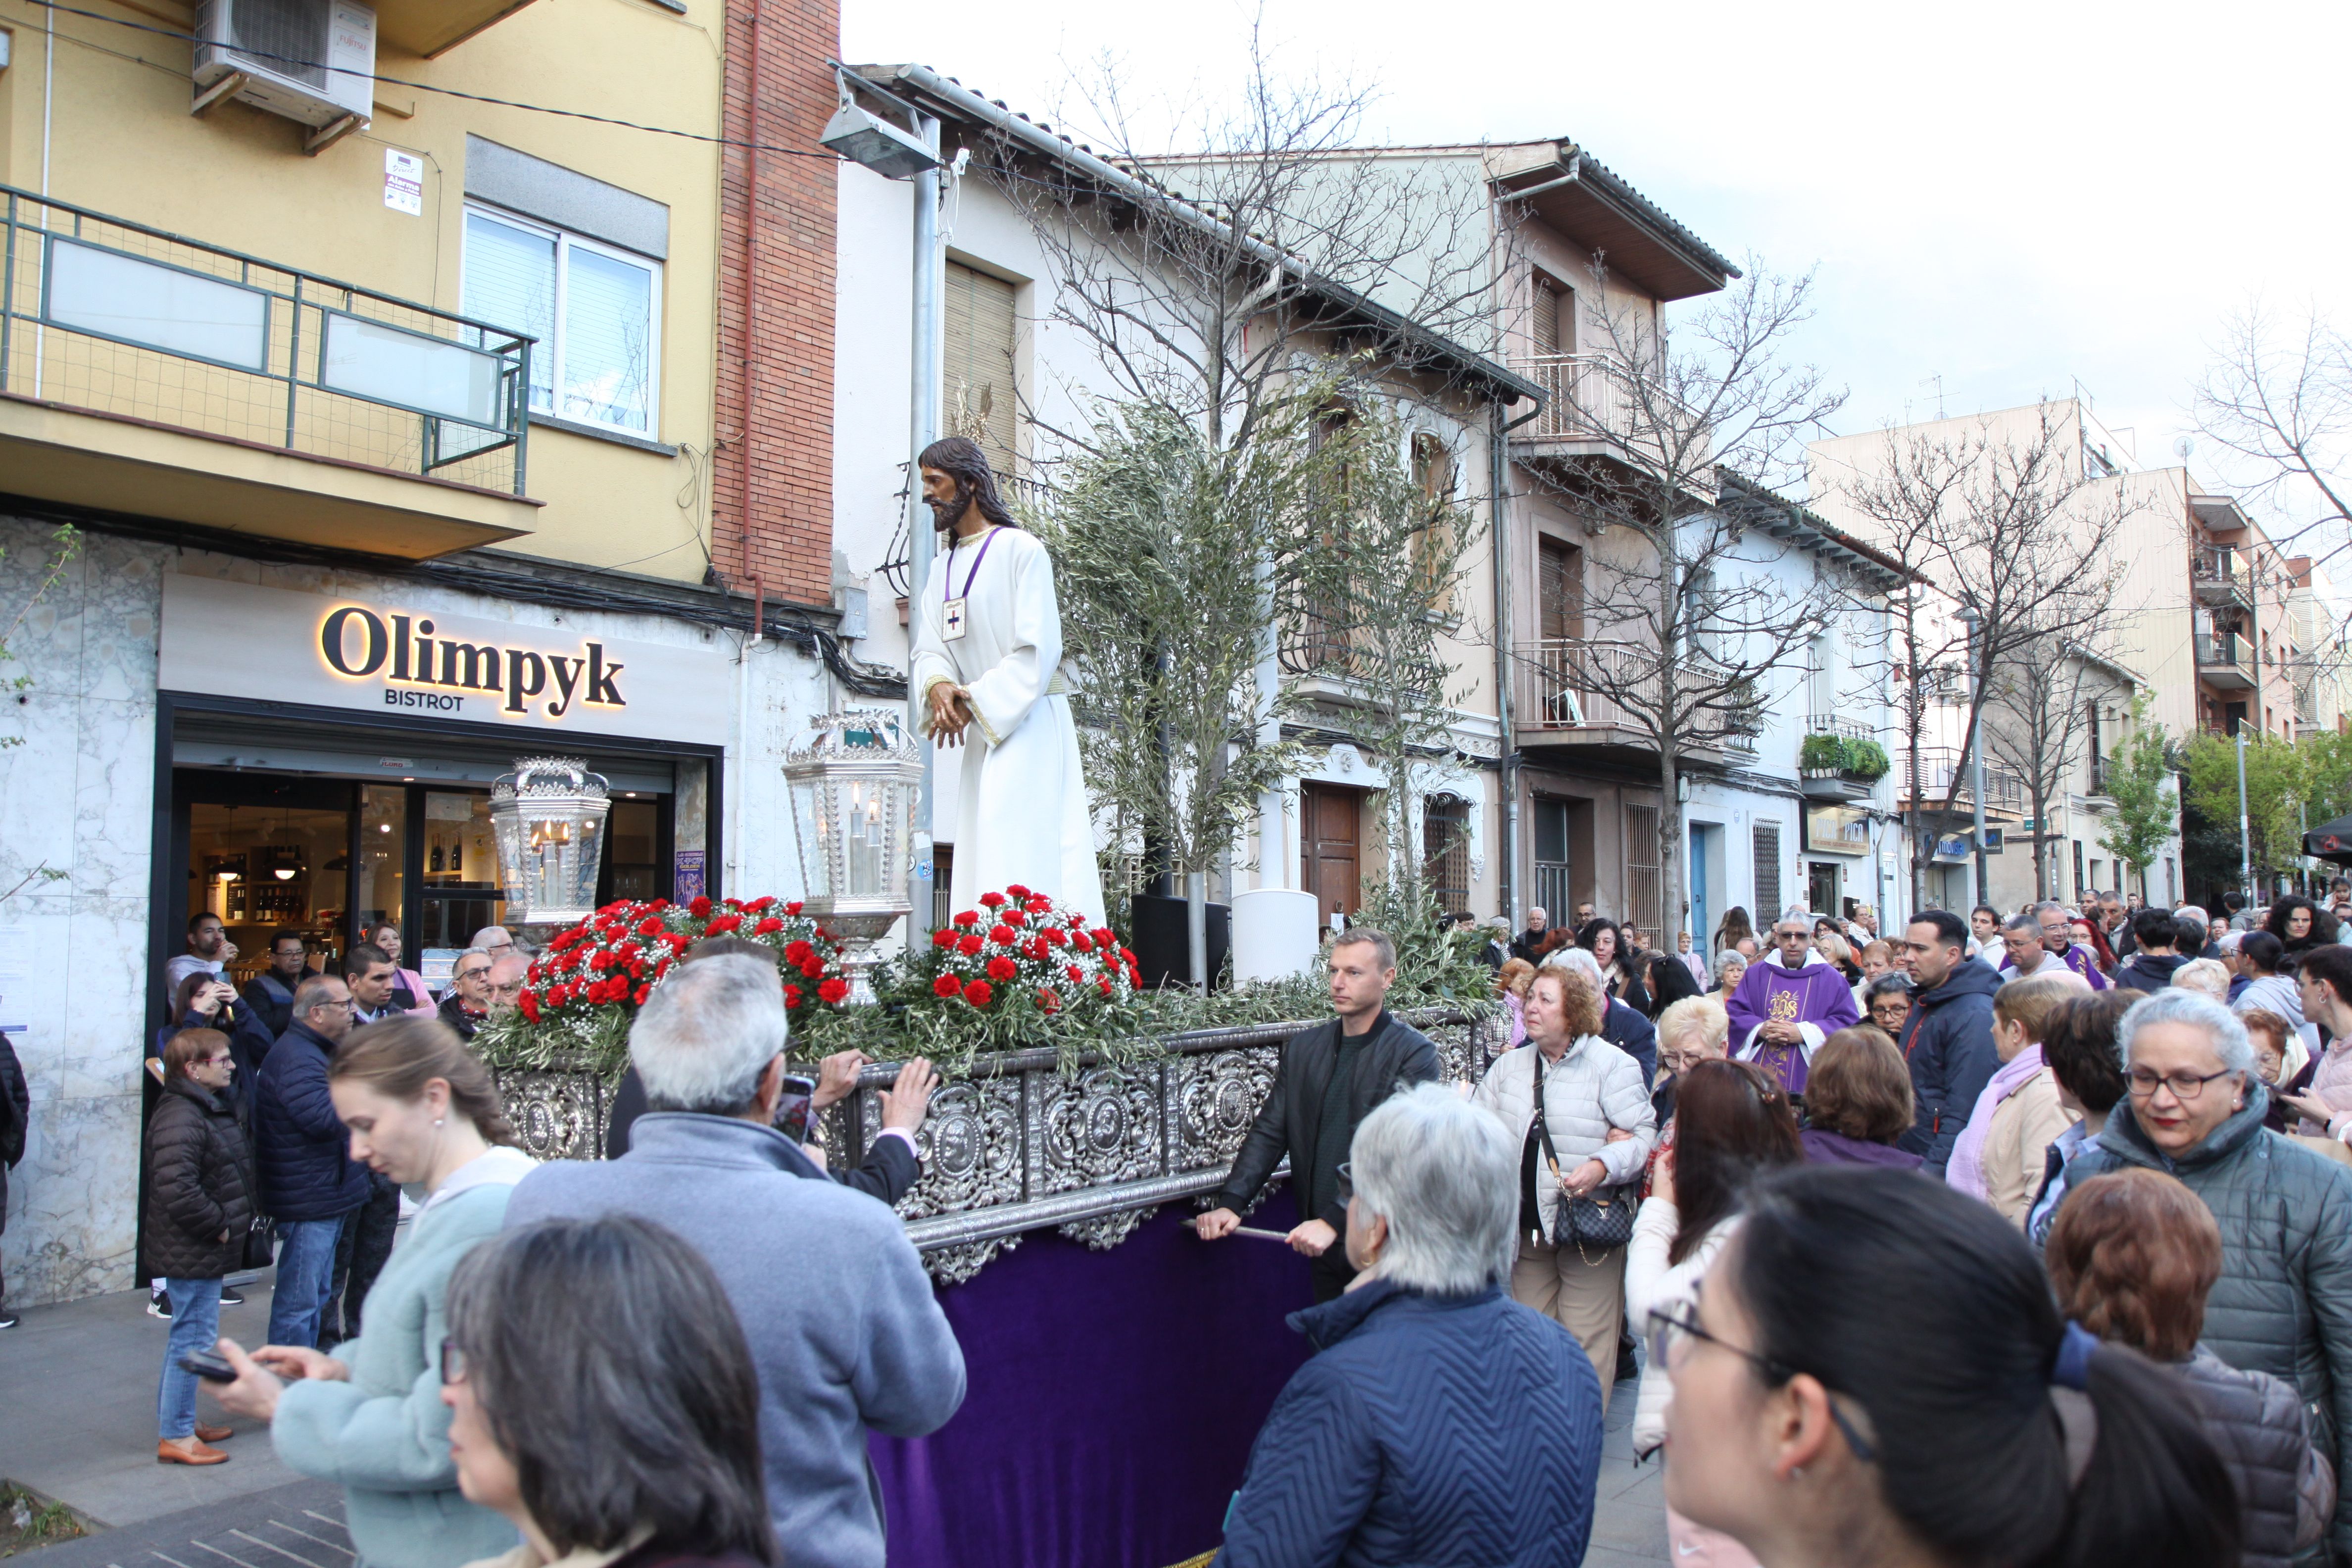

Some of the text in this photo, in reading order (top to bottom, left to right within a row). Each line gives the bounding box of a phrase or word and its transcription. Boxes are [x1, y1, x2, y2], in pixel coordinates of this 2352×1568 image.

[340, 35, 367, 50] FUJITSU
[392, 164, 416, 173] Direct
[388, 176, 419, 191] Alarma
[322, 607, 627, 717] Olimpyk
[385, 689, 464, 712] BISTROT
[1815, 818, 1863, 842] PICA PICA
[677, 857, 703, 865] K-POP
